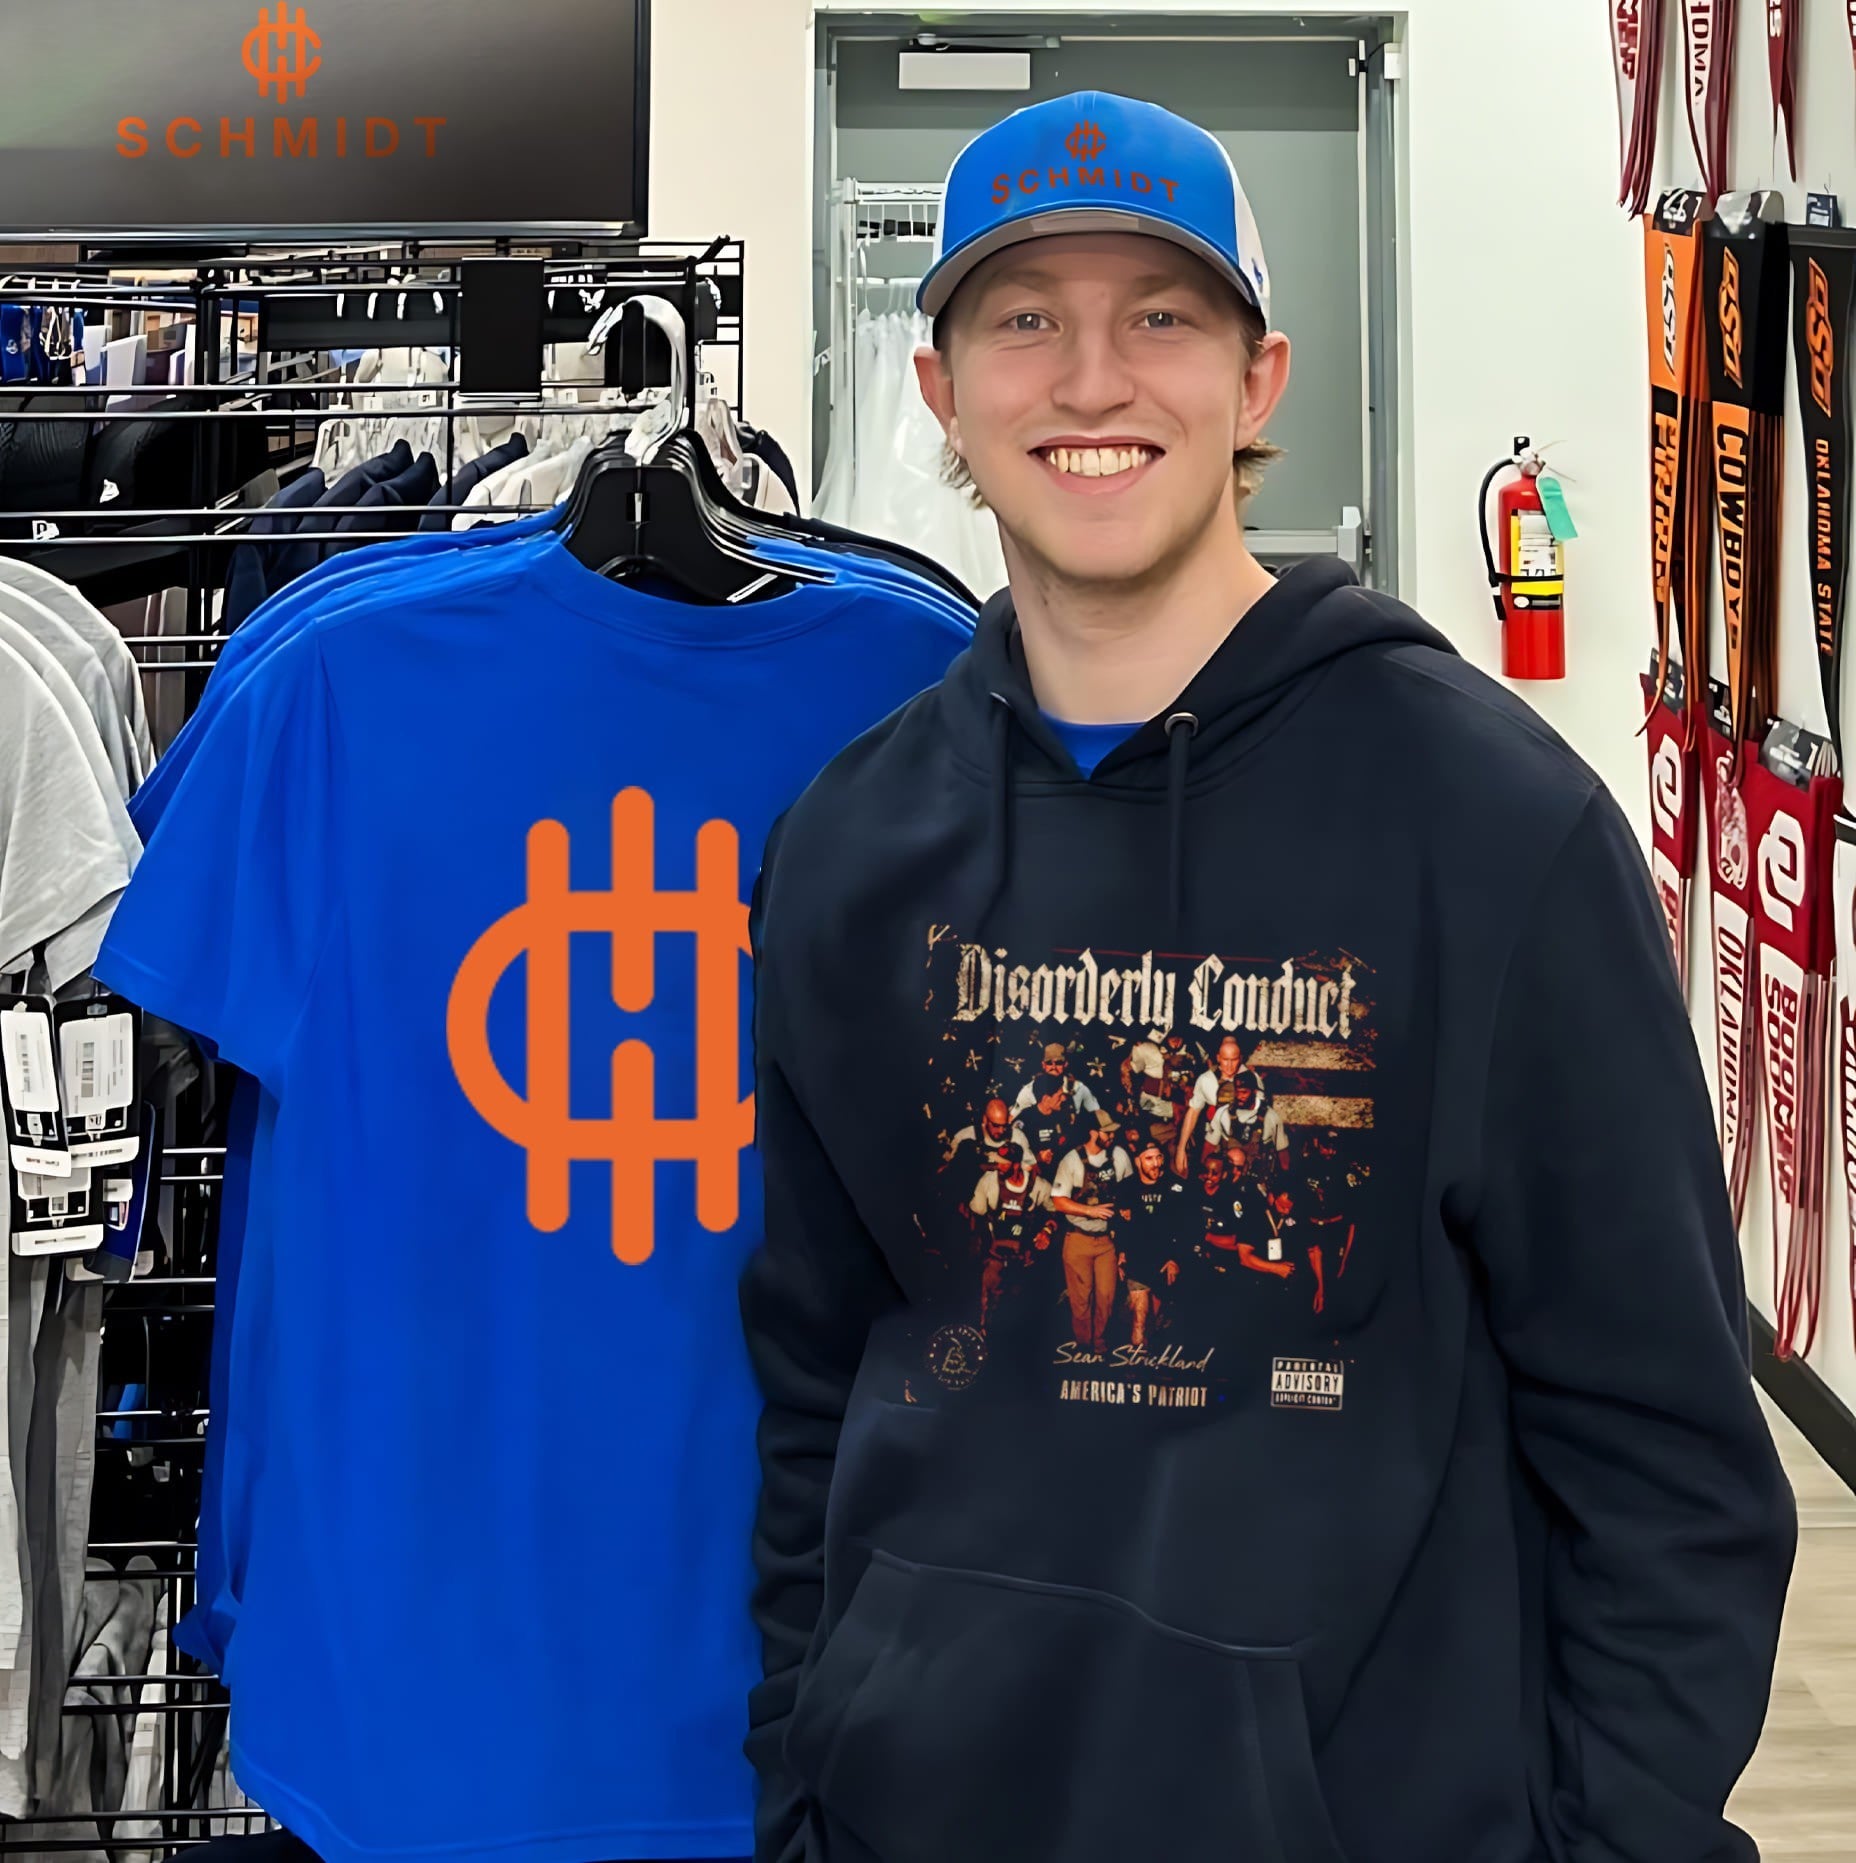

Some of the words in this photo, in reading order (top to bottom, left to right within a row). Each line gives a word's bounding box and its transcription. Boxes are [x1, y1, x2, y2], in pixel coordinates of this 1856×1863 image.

[115, 116, 448, 159] SCHMIDT
[991, 166, 1180, 205] SCHMIDT
[1815, 438, 1832, 570] OKLAHOMA
[950, 943, 1177, 1042] Disorderly
[1187, 953, 1357, 1040] Conduct
[1718, 926, 1746, 1144] OKLAHOMA
[1053, 1341, 1105, 1365] Sean
[1109, 1342, 1216, 1374] Strickland
[1060, 1379, 1142, 1405] AMERICA'S
[1148, 1384, 1208, 1408] PATRIOT
[1275, 1373, 1339, 1393] ADVISORY
